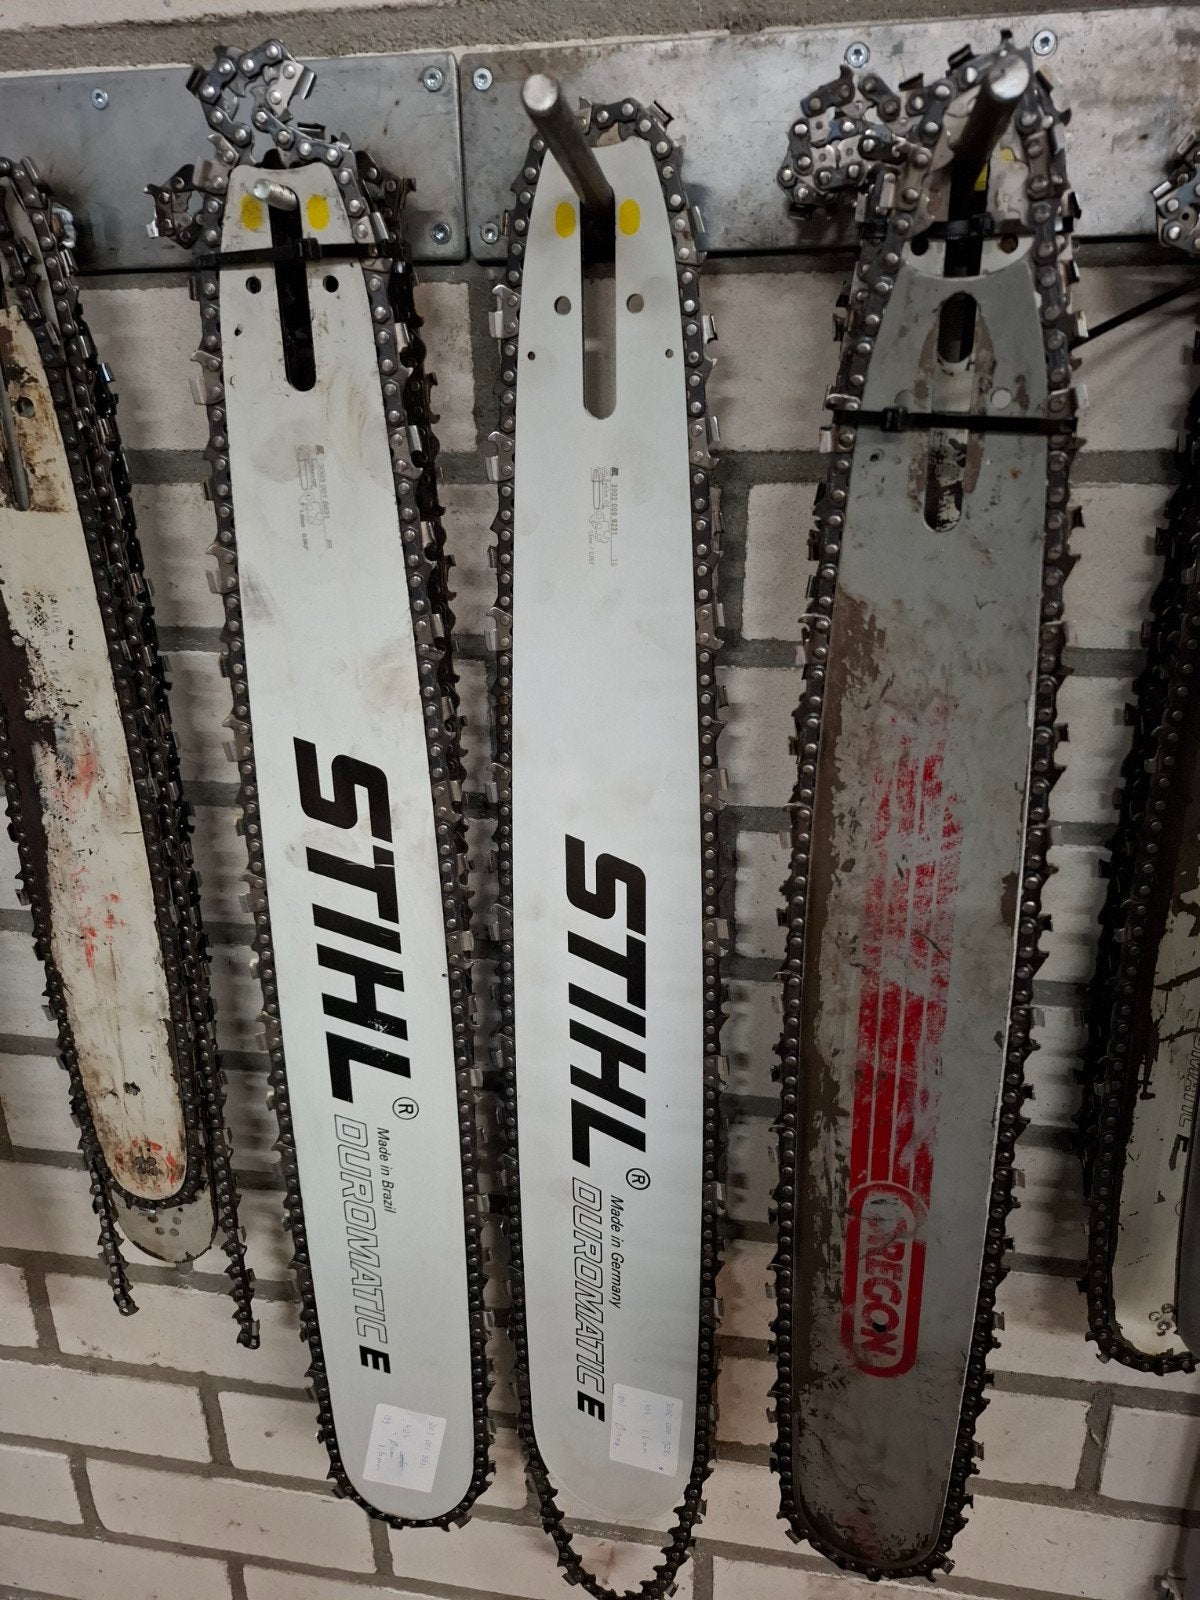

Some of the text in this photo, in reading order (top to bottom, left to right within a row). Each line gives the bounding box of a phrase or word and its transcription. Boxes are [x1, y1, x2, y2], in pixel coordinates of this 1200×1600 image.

[293, 736, 411, 1103] STIHL
[565, 833, 647, 1167] STIHL
[333, 1113, 391, 1375] DUROMATIC E
[377, 1127, 397, 1213] Made in Brazil
[609, 1194, 625, 1307] Made in Germany
[572, 1177, 605, 1422] DUROMATIC E
